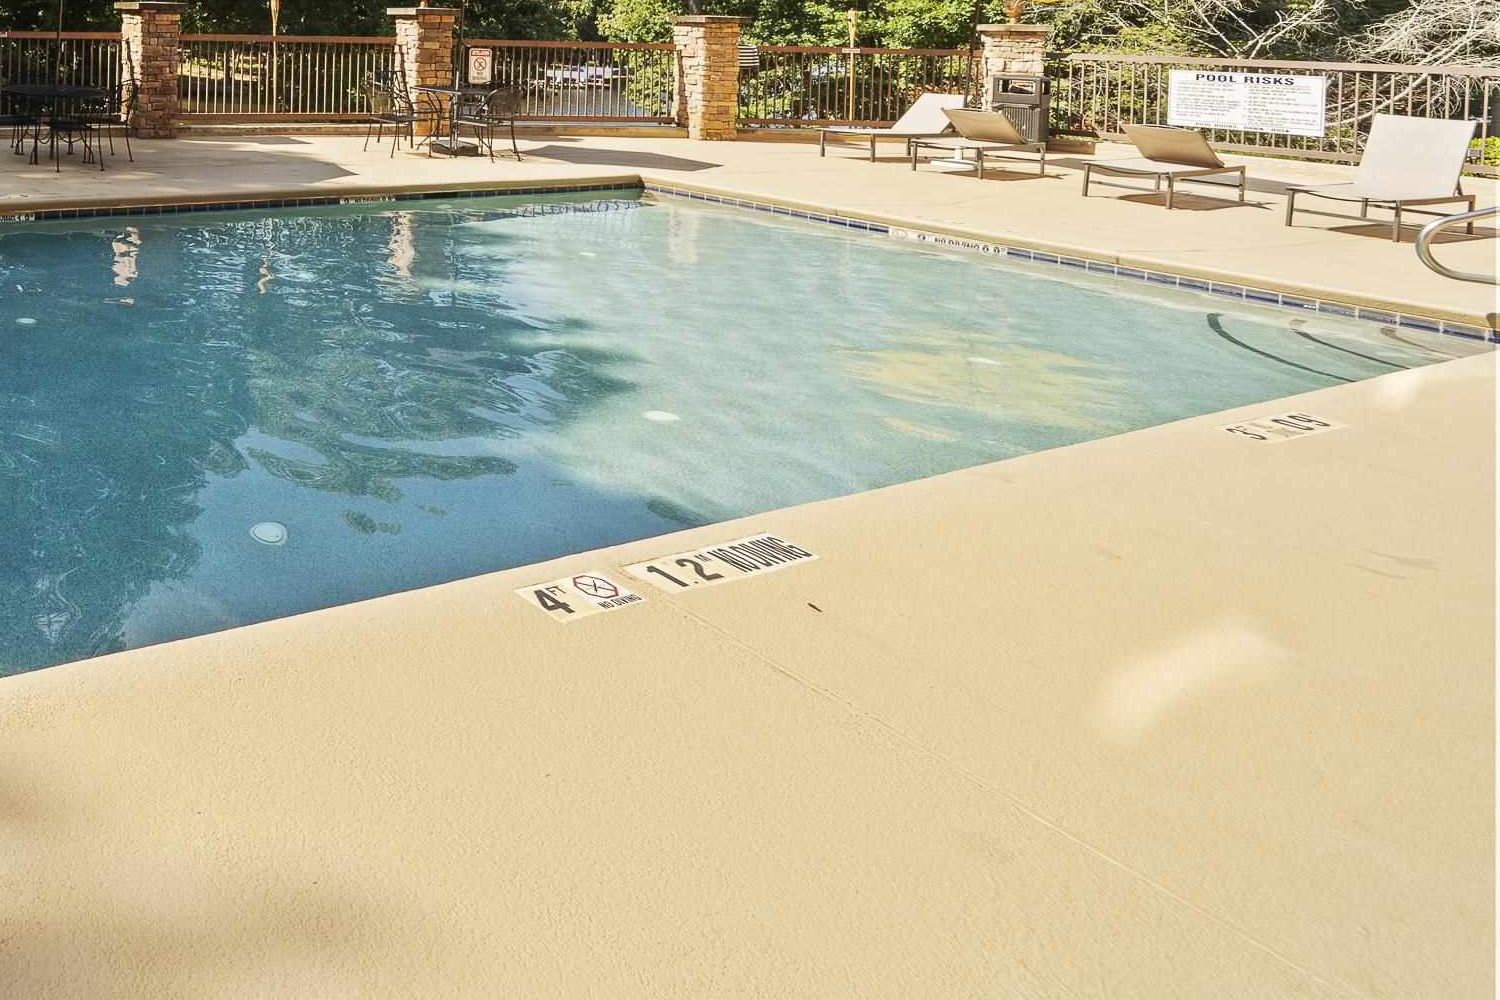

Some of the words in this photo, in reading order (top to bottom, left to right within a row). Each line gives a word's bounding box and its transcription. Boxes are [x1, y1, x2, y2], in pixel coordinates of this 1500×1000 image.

[1196, 74, 1237, 83] POOL
[1244, 76, 1295, 86] RISKS
[706, 548, 761, 573] NO
[728, 536, 813, 567] DIVING
[534, 589, 576, 614] 4
